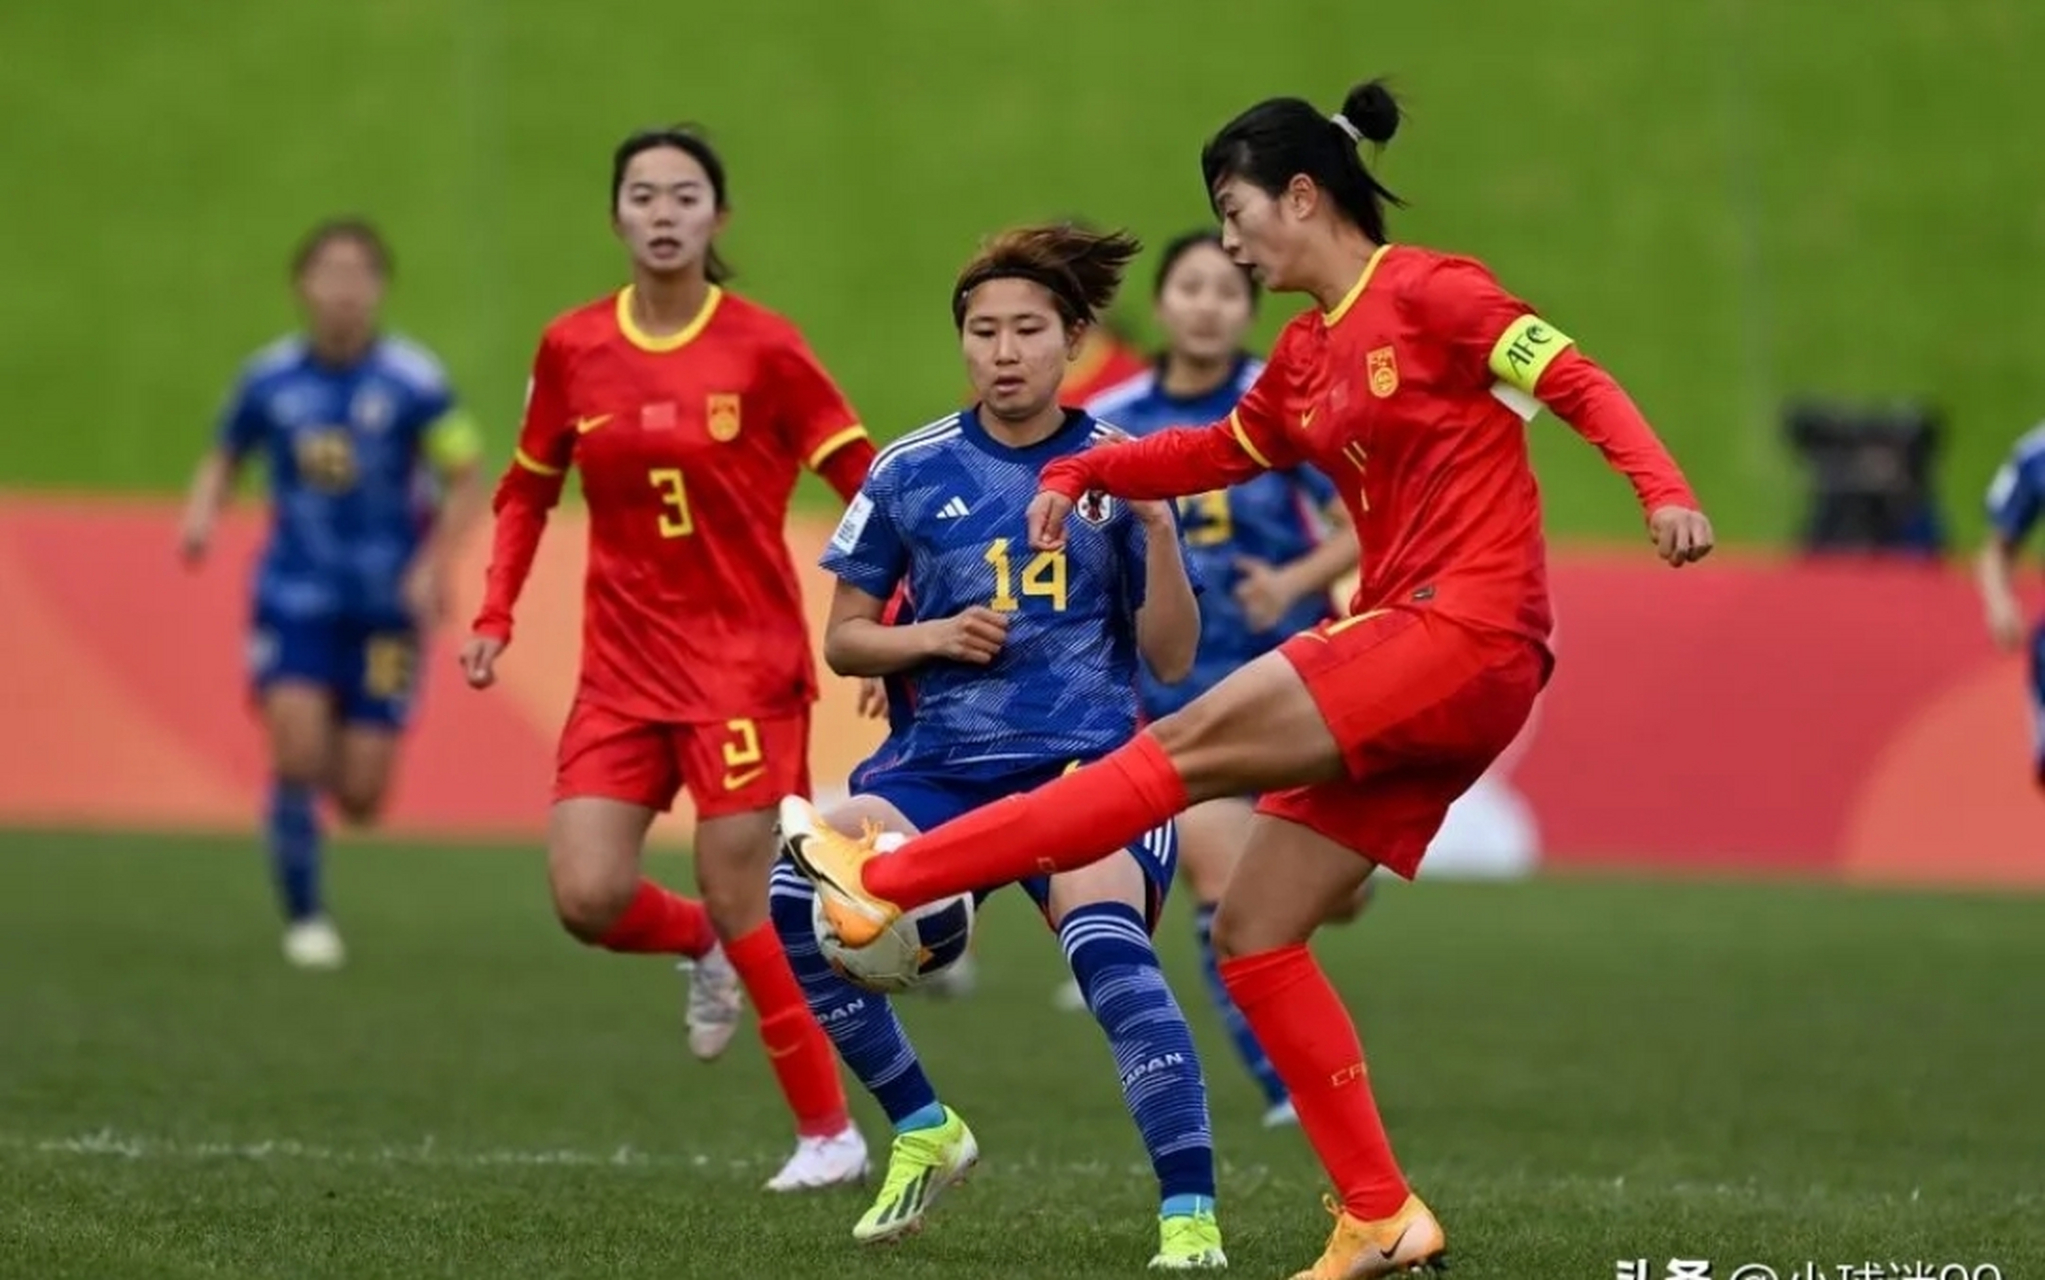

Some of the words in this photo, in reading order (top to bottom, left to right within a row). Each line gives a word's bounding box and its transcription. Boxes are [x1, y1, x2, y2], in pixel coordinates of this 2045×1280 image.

[1506, 325, 1553, 379] AFC
[649, 467, 695, 539] 3
[983, 538, 1068, 612] 14
